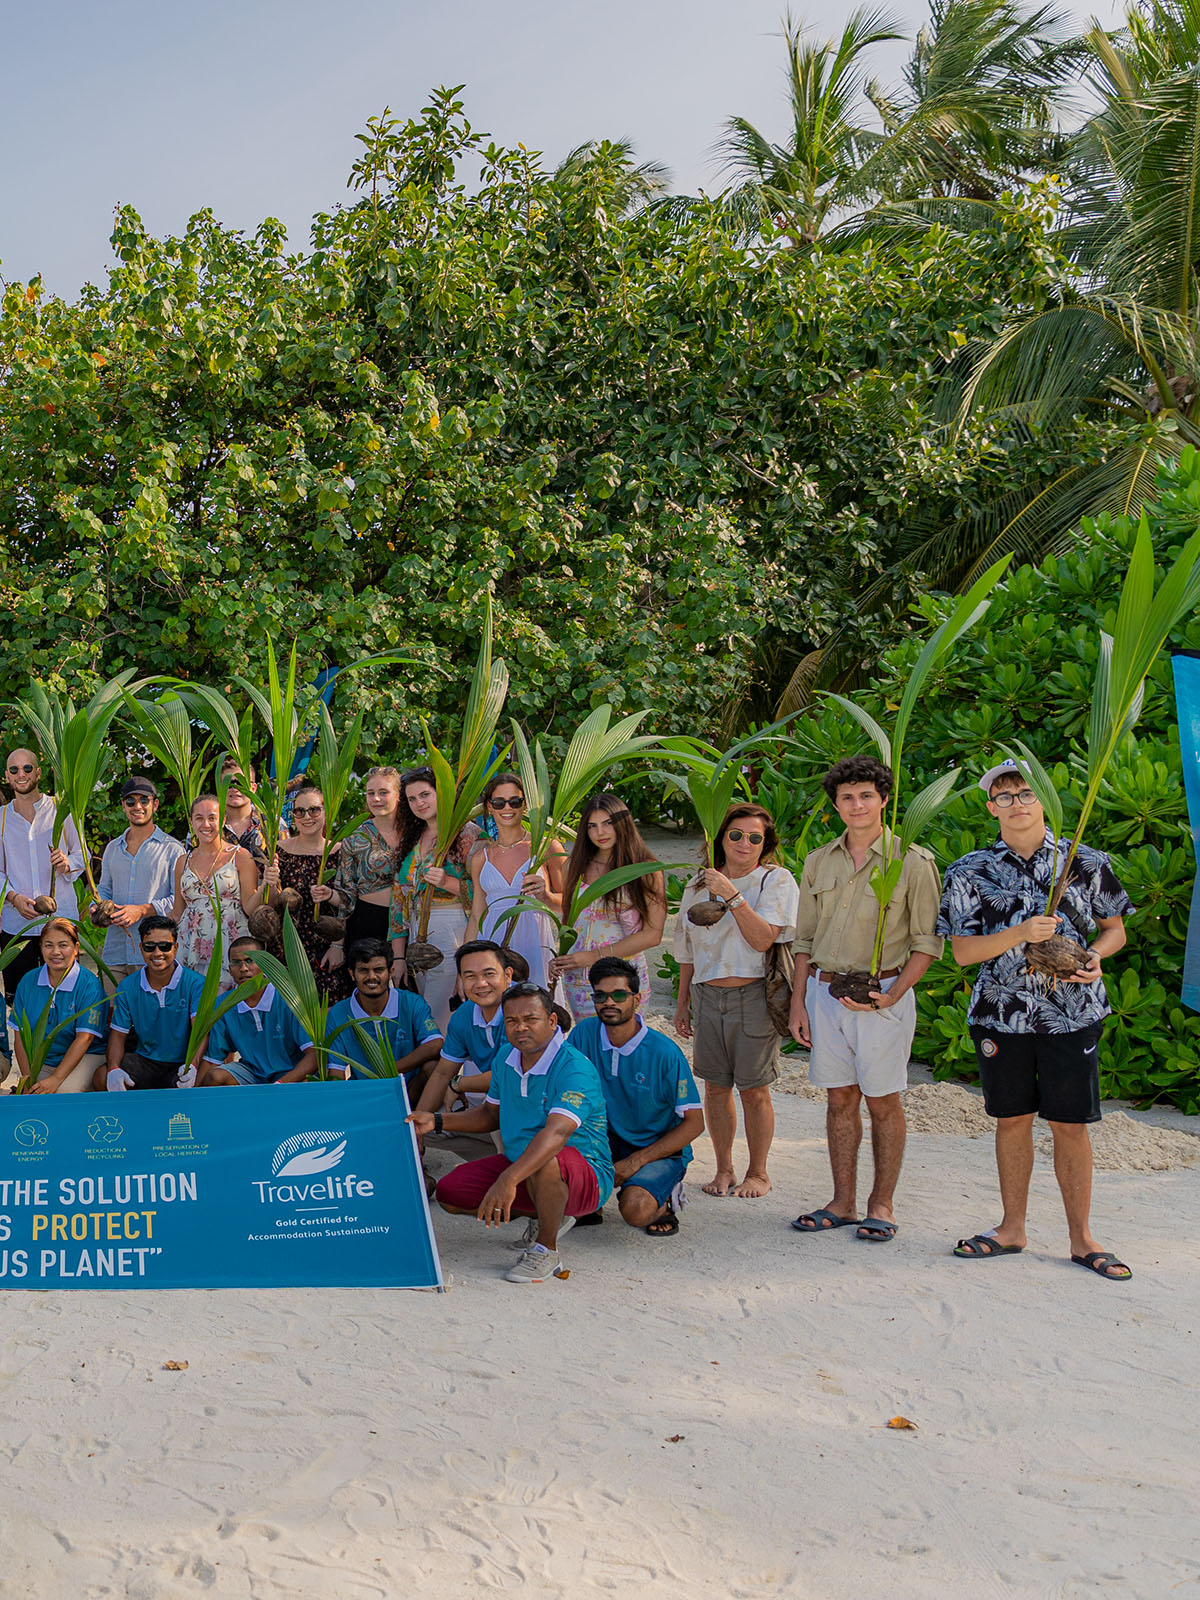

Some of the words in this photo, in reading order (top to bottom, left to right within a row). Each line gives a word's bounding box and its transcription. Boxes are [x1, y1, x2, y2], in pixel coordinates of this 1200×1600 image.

[59, 1172, 198, 1205] SOLUTION
[251, 1174, 375, 1203] Travelife
[32, 1211, 157, 1241] PROTECT
[247, 1230, 323, 1241] Accommodation
[325, 1225, 390, 1237] Sustainability
[275, 1218, 298, 1227] Gold
[300, 1216, 342, 1226] Certified
[344, 1215, 359, 1223] for
